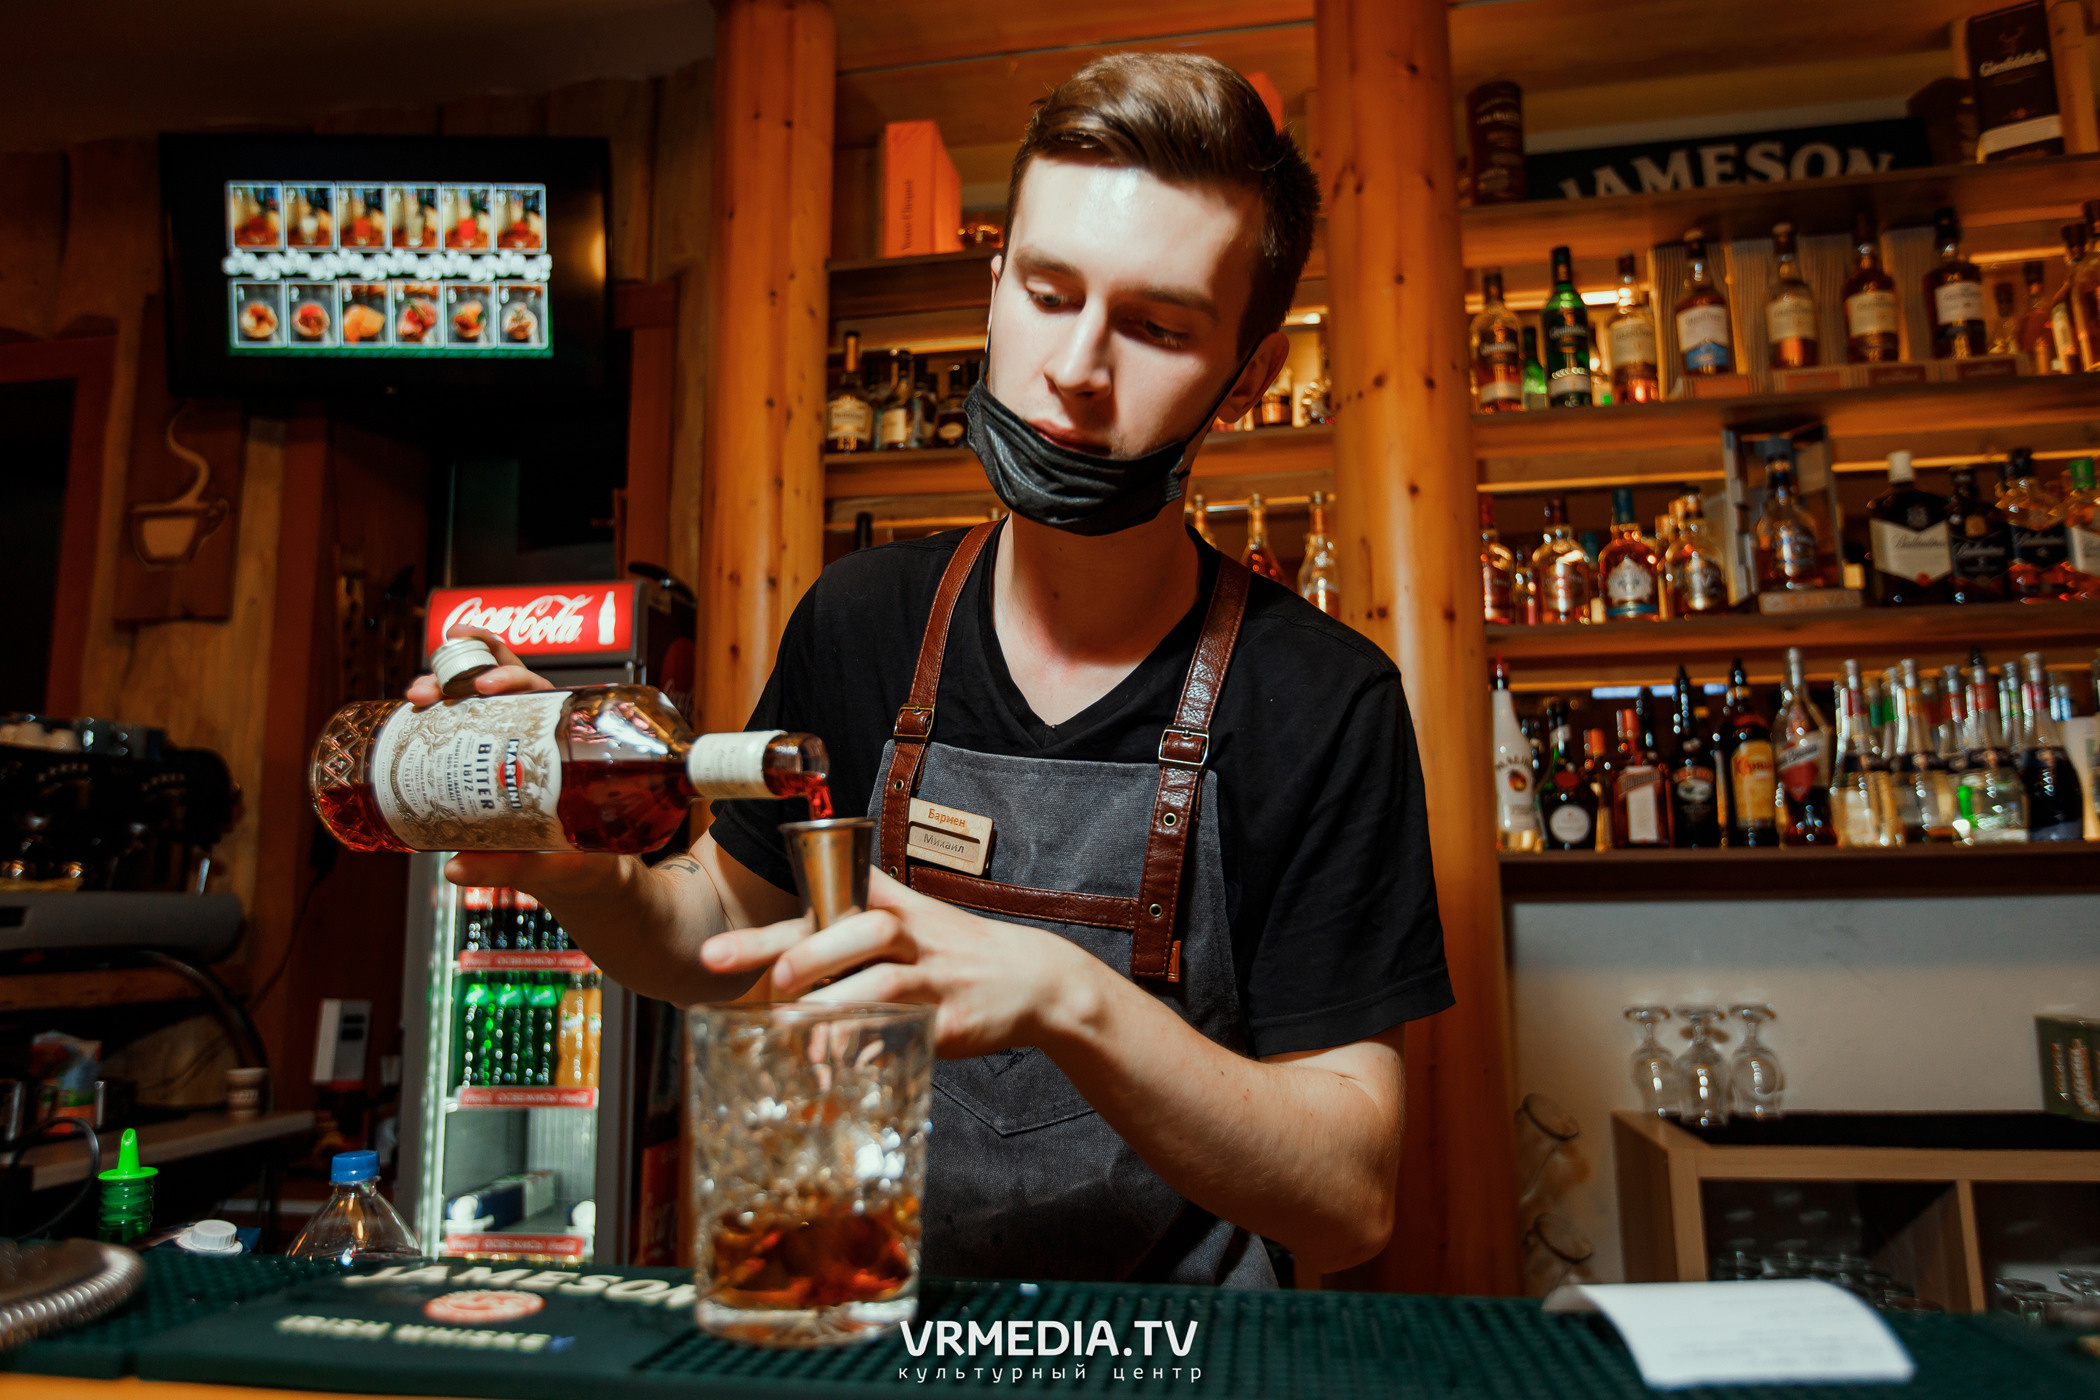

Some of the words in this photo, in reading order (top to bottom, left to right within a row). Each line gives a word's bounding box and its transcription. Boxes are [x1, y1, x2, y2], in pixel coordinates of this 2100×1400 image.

[442, 596, 595, 646] Coca-Cola
[464, 762, 474, 793] 1872
[476, 743, 495, 810] BITTER
[506, 740, 521, 809] MARTINI
[928, 808, 966, 828] Бармен
[923, 833, 965, 854] Михаил
[343, 1265, 698, 1308] JAMESON
[275, 1315, 392, 1341] IRISH
